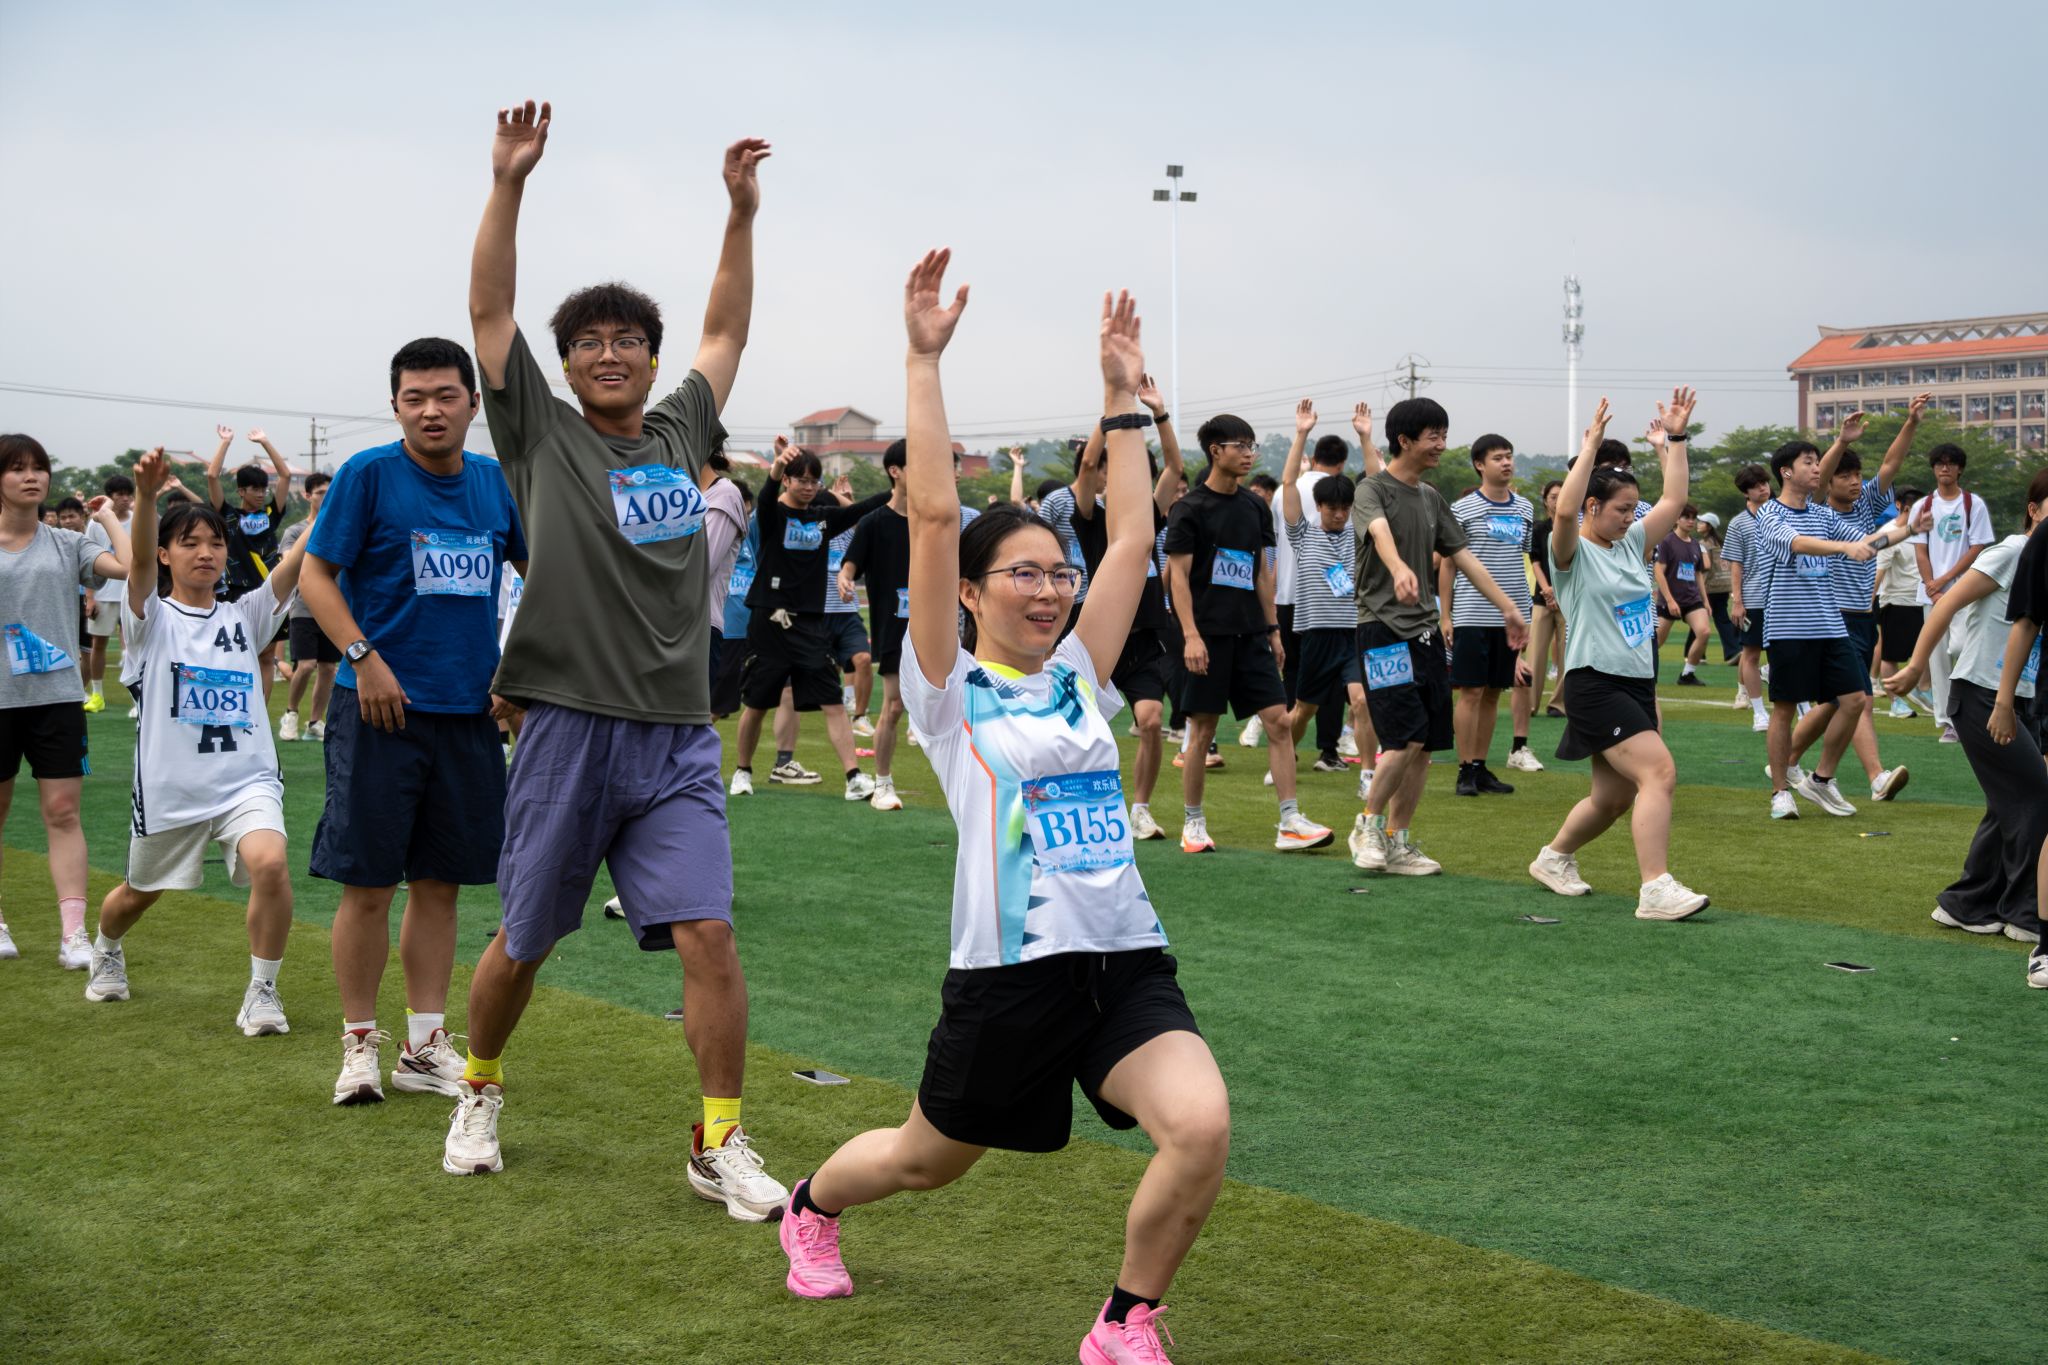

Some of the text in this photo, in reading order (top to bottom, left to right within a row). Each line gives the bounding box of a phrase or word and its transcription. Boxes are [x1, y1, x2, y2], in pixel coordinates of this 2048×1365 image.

[622, 487, 707, 526] A092
[418, 552, 490, 580] A090
[214, 621, 249, 653] 44
[183, 686, 249, 714] A081
[1034, 804, 1126, 851] B155
